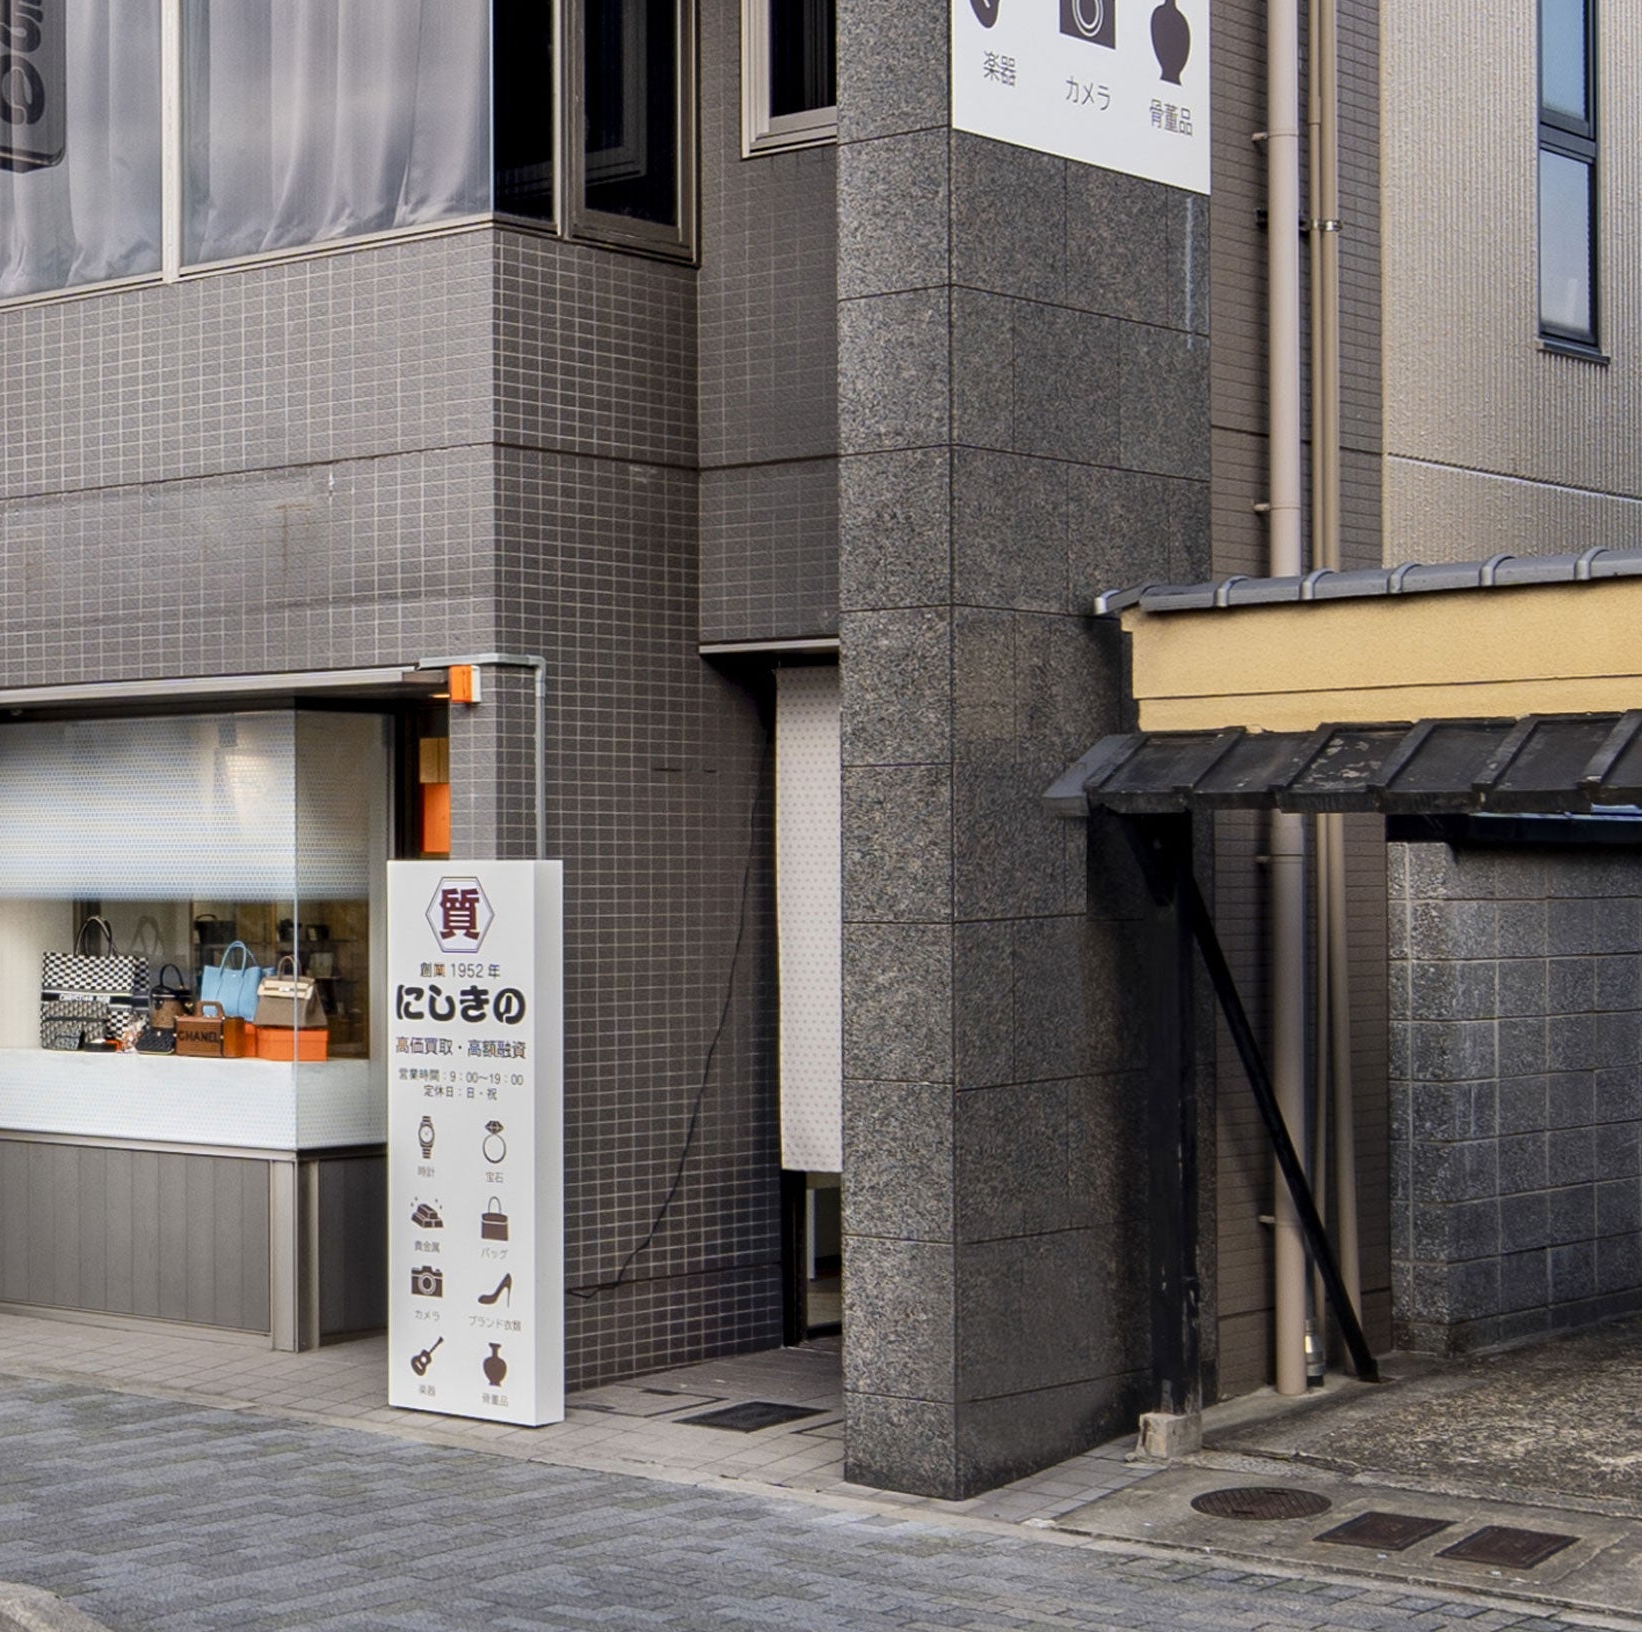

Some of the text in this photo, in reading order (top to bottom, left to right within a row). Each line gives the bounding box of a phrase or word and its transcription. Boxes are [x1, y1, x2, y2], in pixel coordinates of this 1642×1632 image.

[983, 50, 1016, 87] 楽器
[1065, 75, 1111, 112] カメラ
[1149, 98, 1193, 138] 骨董品
[439, 888, 480, 940] 質
[451, 963, 483, 979] 1952
[488, 963, 501, 979] 年
[396, 984, 527, 1025] にしきの
